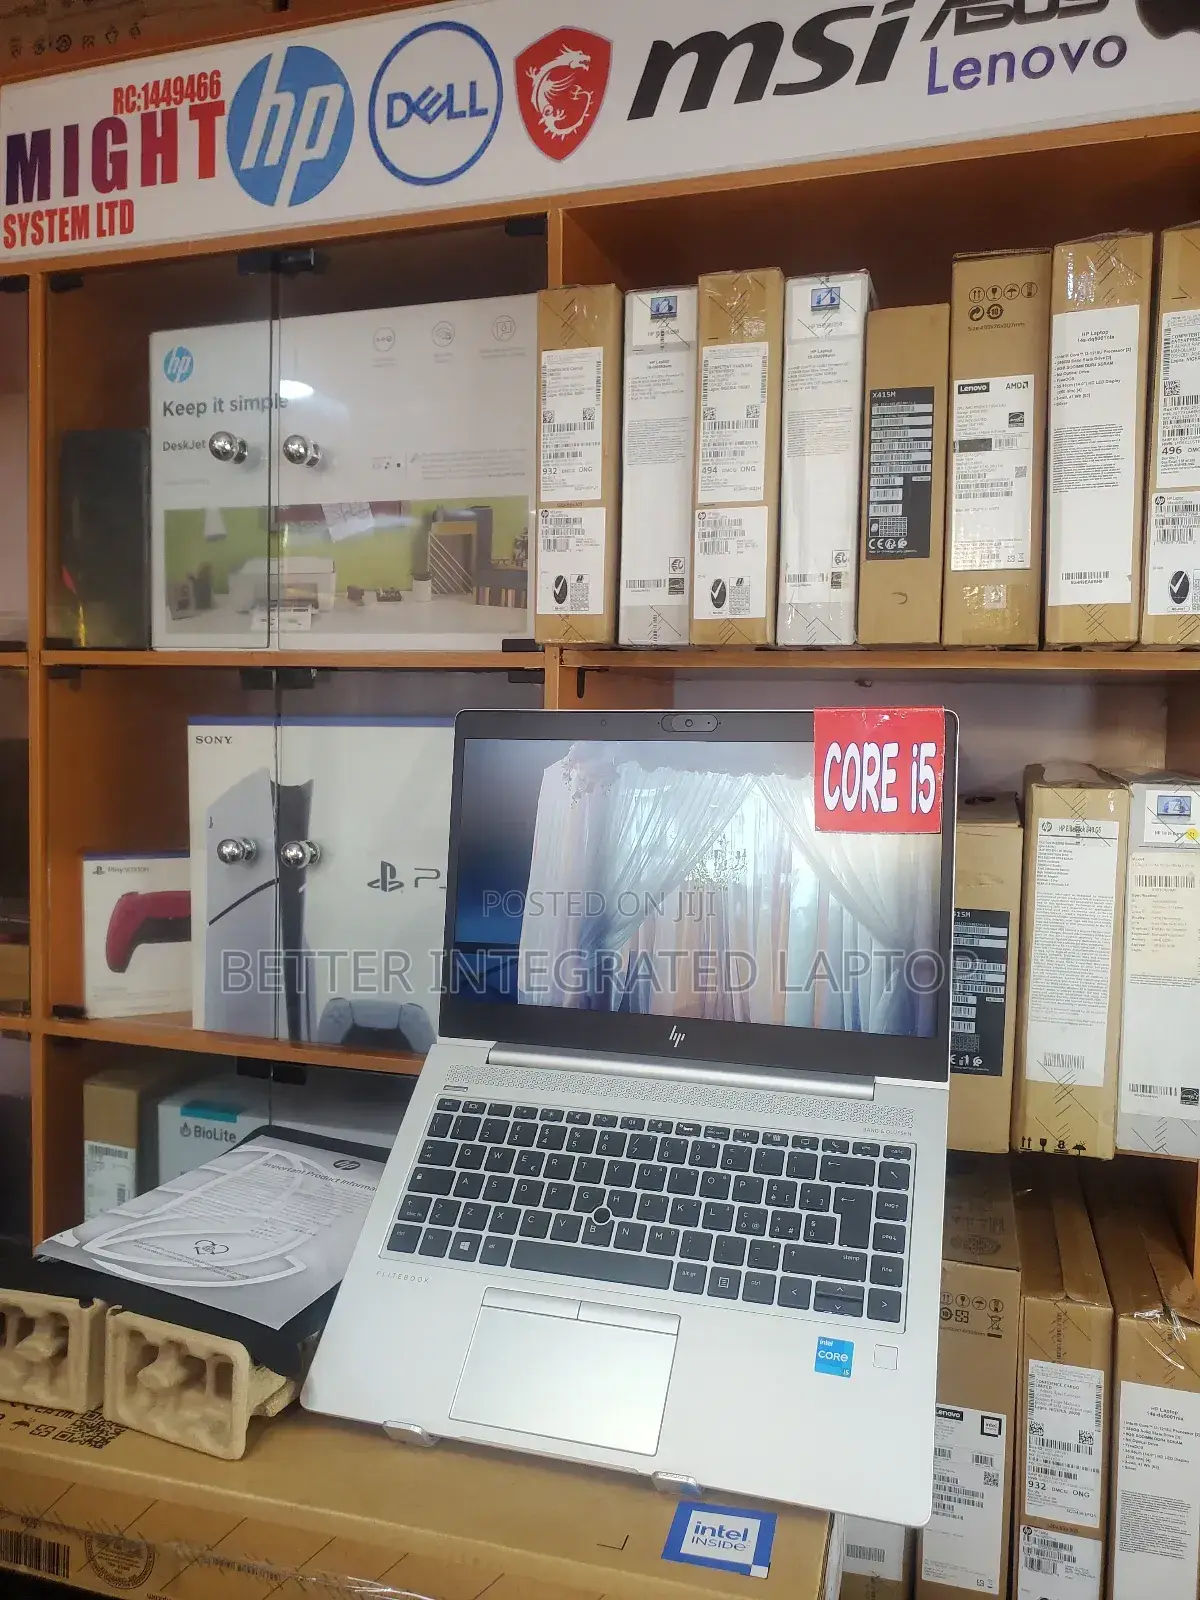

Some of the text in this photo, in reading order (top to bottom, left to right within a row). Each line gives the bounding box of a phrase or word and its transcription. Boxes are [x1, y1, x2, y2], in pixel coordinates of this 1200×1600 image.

[627, 0, 913, 121] msi
[927, 34, 1128, 96] Lenovo
[112, 69, 222, 117] RC:1449466
[386, 80, 489, 129] DELL
[236, 46, 347, 206] hp
[4, 101, 227, 205] MIGHT
[3, 198, 135, 249] SYSTEM LTD
[1006, 382, 1022, 390] AMD
[162, 392, 289, 418] Keep it simple
[162, 439, 207, 452] DeskJet
[1161, 447, 1182, 455] 496
[195, 735, 233, 745] SONY
[822, 740, 938, 816] CORE i5
[193, 1124, 237, 1144] BioLite
[494, 1151, 503, 1159] W
[552, 1158, 558, 1166] R
[262, 1162, 307, 1177] Important
[306, 1170, 343, 1184] Product
[613, 1165, 620, 1173] Y
[467, 1208, 473, 1216] Z
[497, 1212, 504, 1220] X
[709, 1208, 716, 1216] L
[559, 1219, 567, 1227] V
[752, 1222, 760, 1230] @
[622, 1228, 630, 1236] N
[820, 1339, 834, 1347] intel
[1028, 1480, 1047, 1491] 932
[1072, 1490, 1090, 1498] ONG
[694, 1521, 749, 1542] intel
